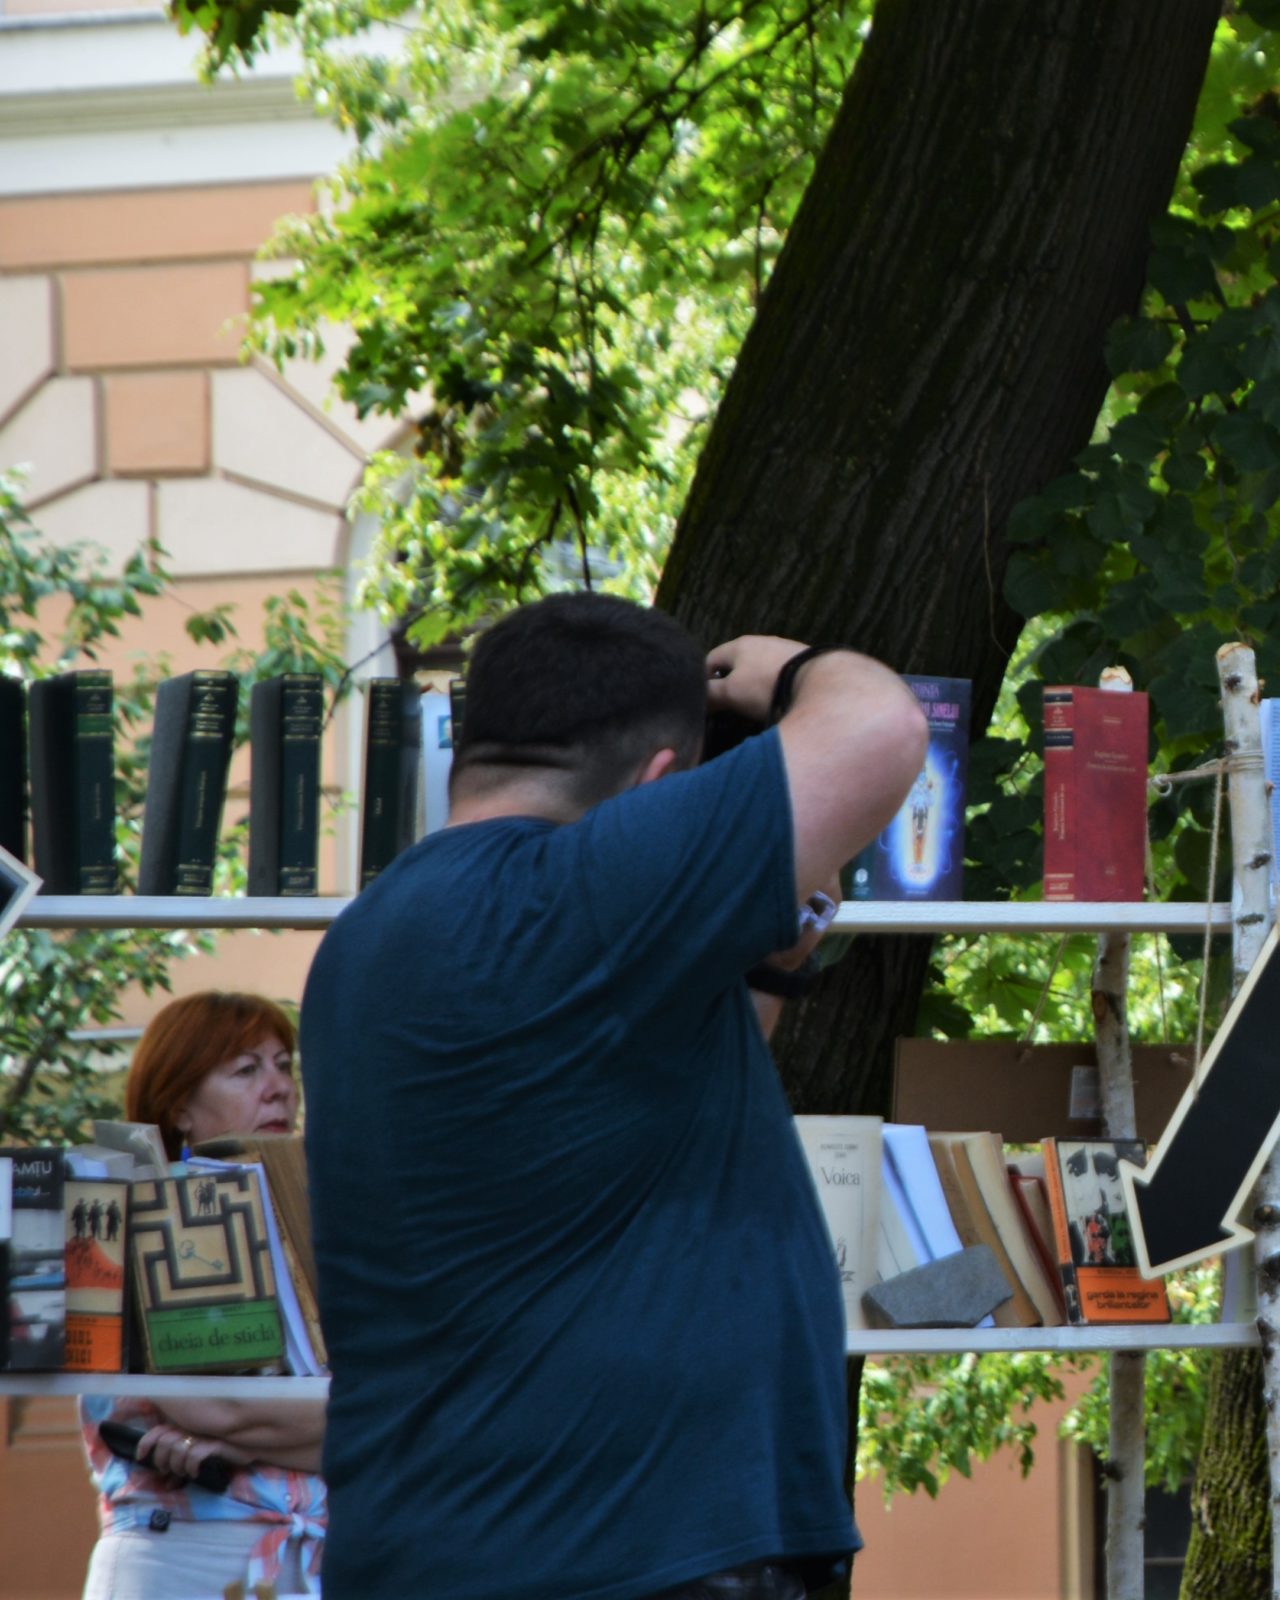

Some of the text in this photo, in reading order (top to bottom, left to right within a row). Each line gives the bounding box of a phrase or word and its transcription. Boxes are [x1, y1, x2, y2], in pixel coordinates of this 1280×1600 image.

[820, 1166, 860, 1186] Voica
[157, 1334, 204, 1353] cheia
[208, 1327, 232, 1347] de
